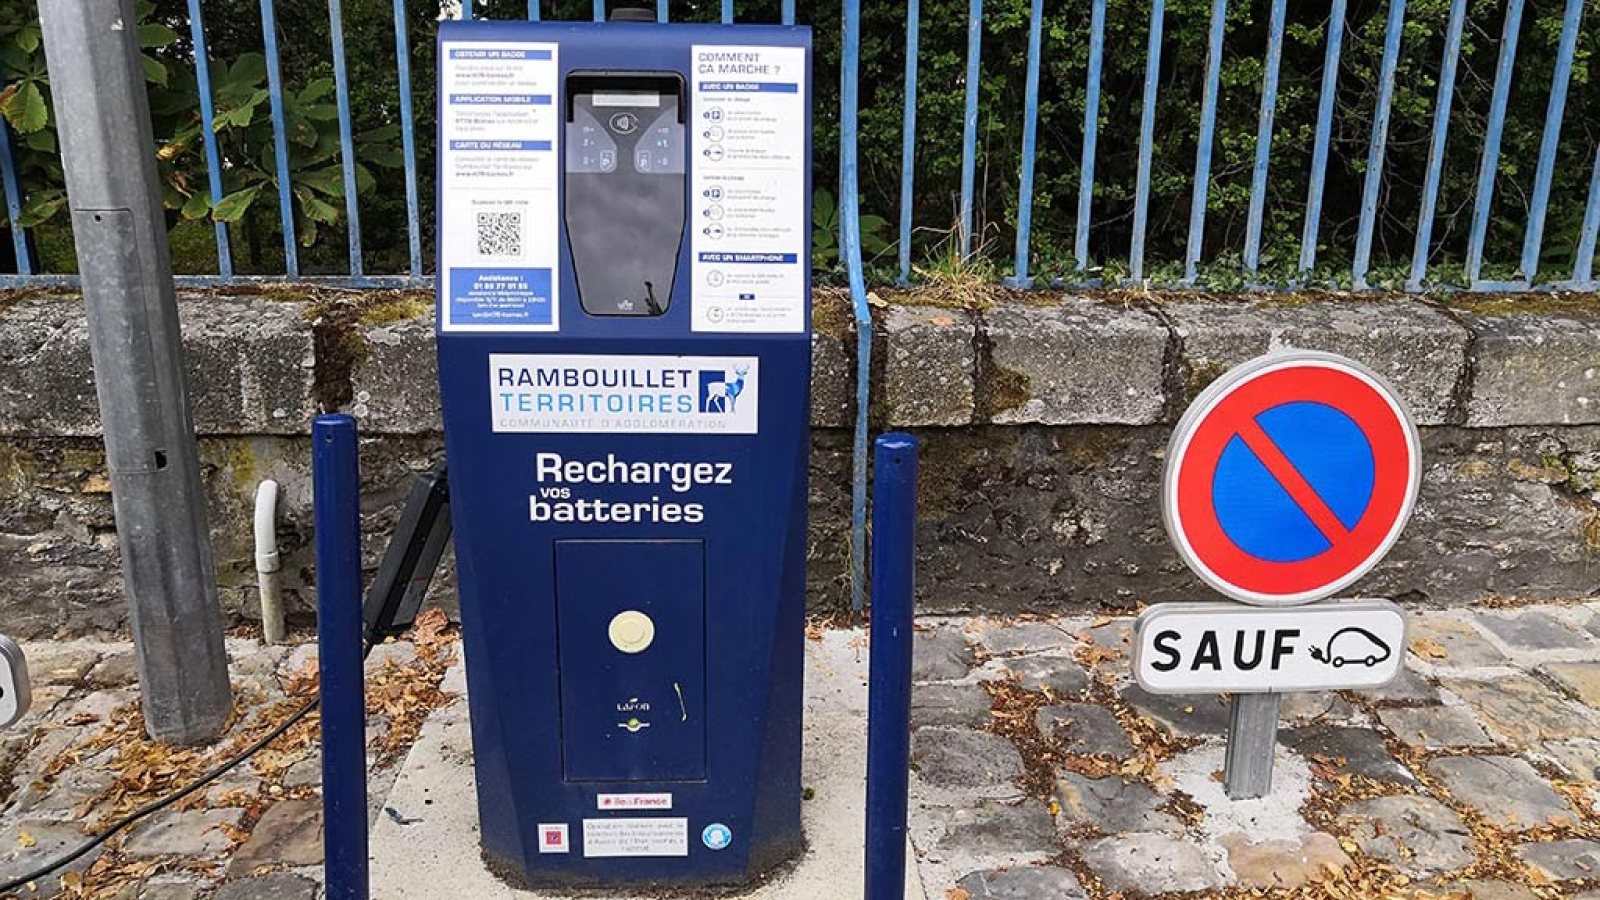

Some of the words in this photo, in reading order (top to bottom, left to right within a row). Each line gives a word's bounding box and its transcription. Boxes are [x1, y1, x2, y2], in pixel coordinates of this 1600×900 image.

[698, 53, 760, 62] COMMENT
[718, 64, 769, 75] MARCHE
[774, 65, 781, 75] ?
[455, 141, 478, 149] CARTE
[498, 368, 692, 388] RAMBOUILLET
[499, 393, 693, 413] TERRITOIRES
[535, 452, 733, 493] Rechargez
[540, 487, 571, 499] vos
[529, 495, 704, 523] batteries
[1150, 629, 1300, 672] SAUF
